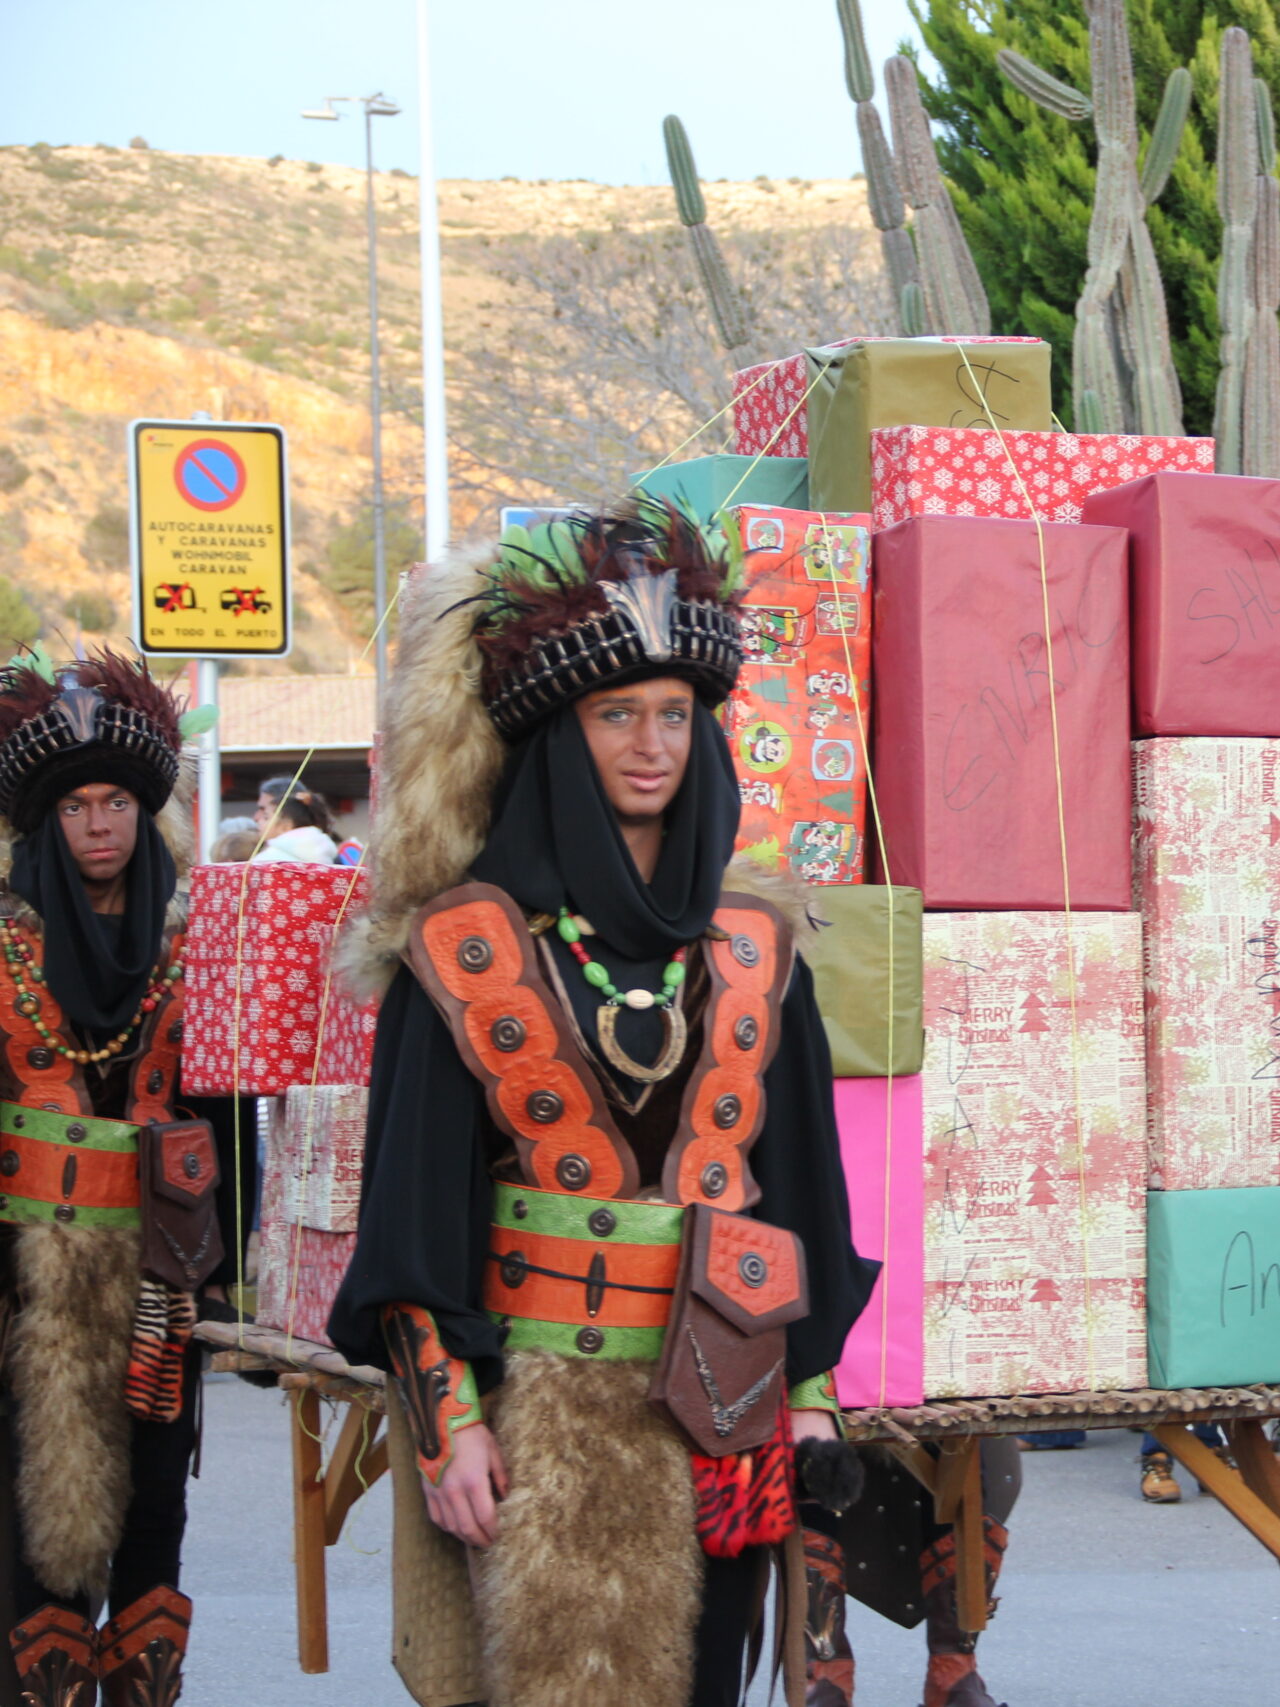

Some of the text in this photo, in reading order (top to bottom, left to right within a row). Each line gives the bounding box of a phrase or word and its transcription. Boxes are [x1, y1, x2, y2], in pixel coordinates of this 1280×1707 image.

[148, 521, 275, 535] AUTOCARAVANAS
[157, 536, 267, 548] Y CARAVANAS
[171, 550, 253, 562] WOHNMOBIL
[178, 564, 247, 575] CARAVAN
[150, 628, 277, 638] EN TODO EL PUERTO
[942, 583, 1120, 812] ENRIC
